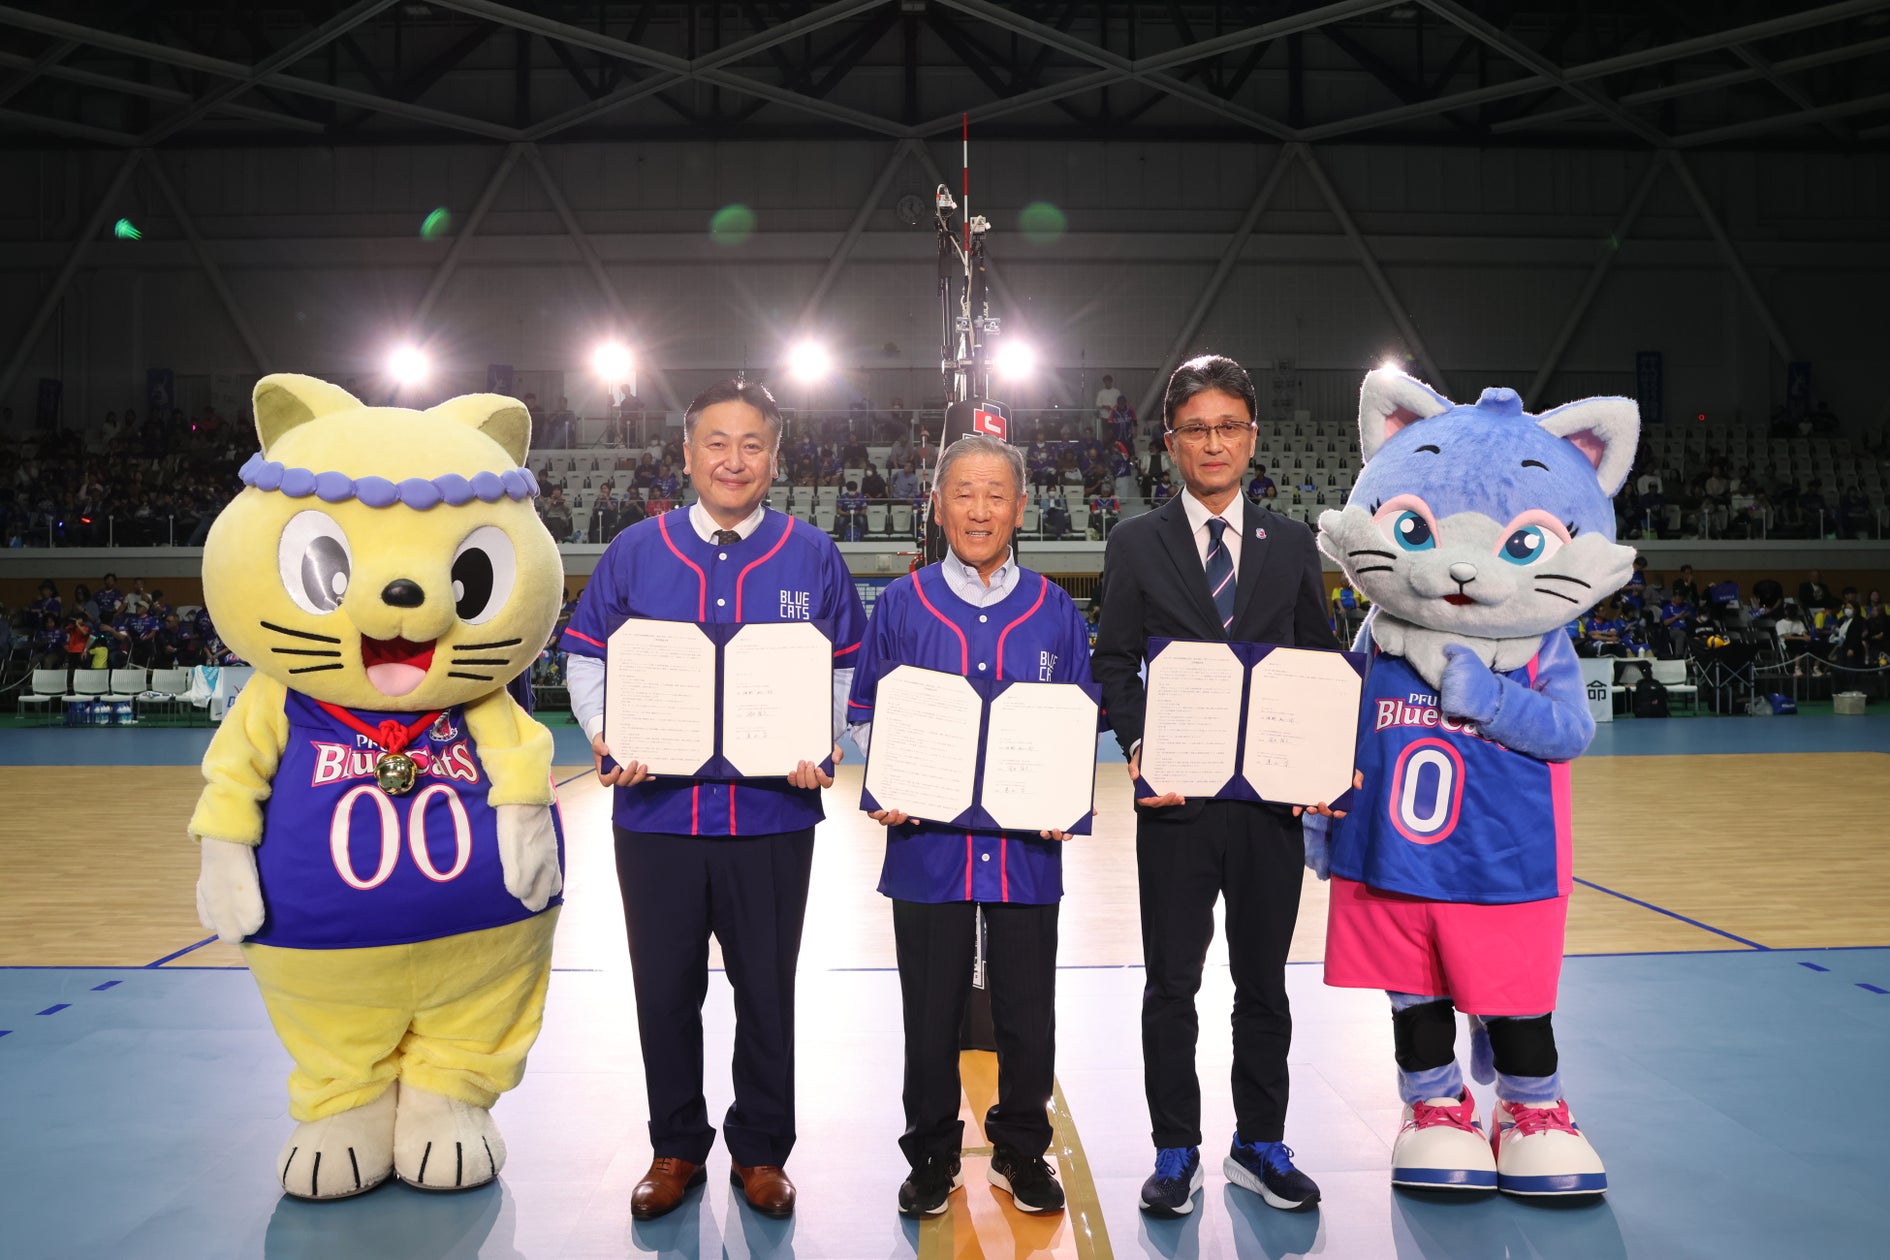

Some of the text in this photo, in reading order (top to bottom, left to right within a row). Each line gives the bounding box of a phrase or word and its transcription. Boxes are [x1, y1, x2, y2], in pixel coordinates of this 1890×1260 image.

[780, 590, 810, 606] BLUE
[780, 604, 810, 620] CATS
[1408, 692, 1438, 706] PFU
[1390, 738, 1464, 843] 0
[330, 783, 472, 890] 00
